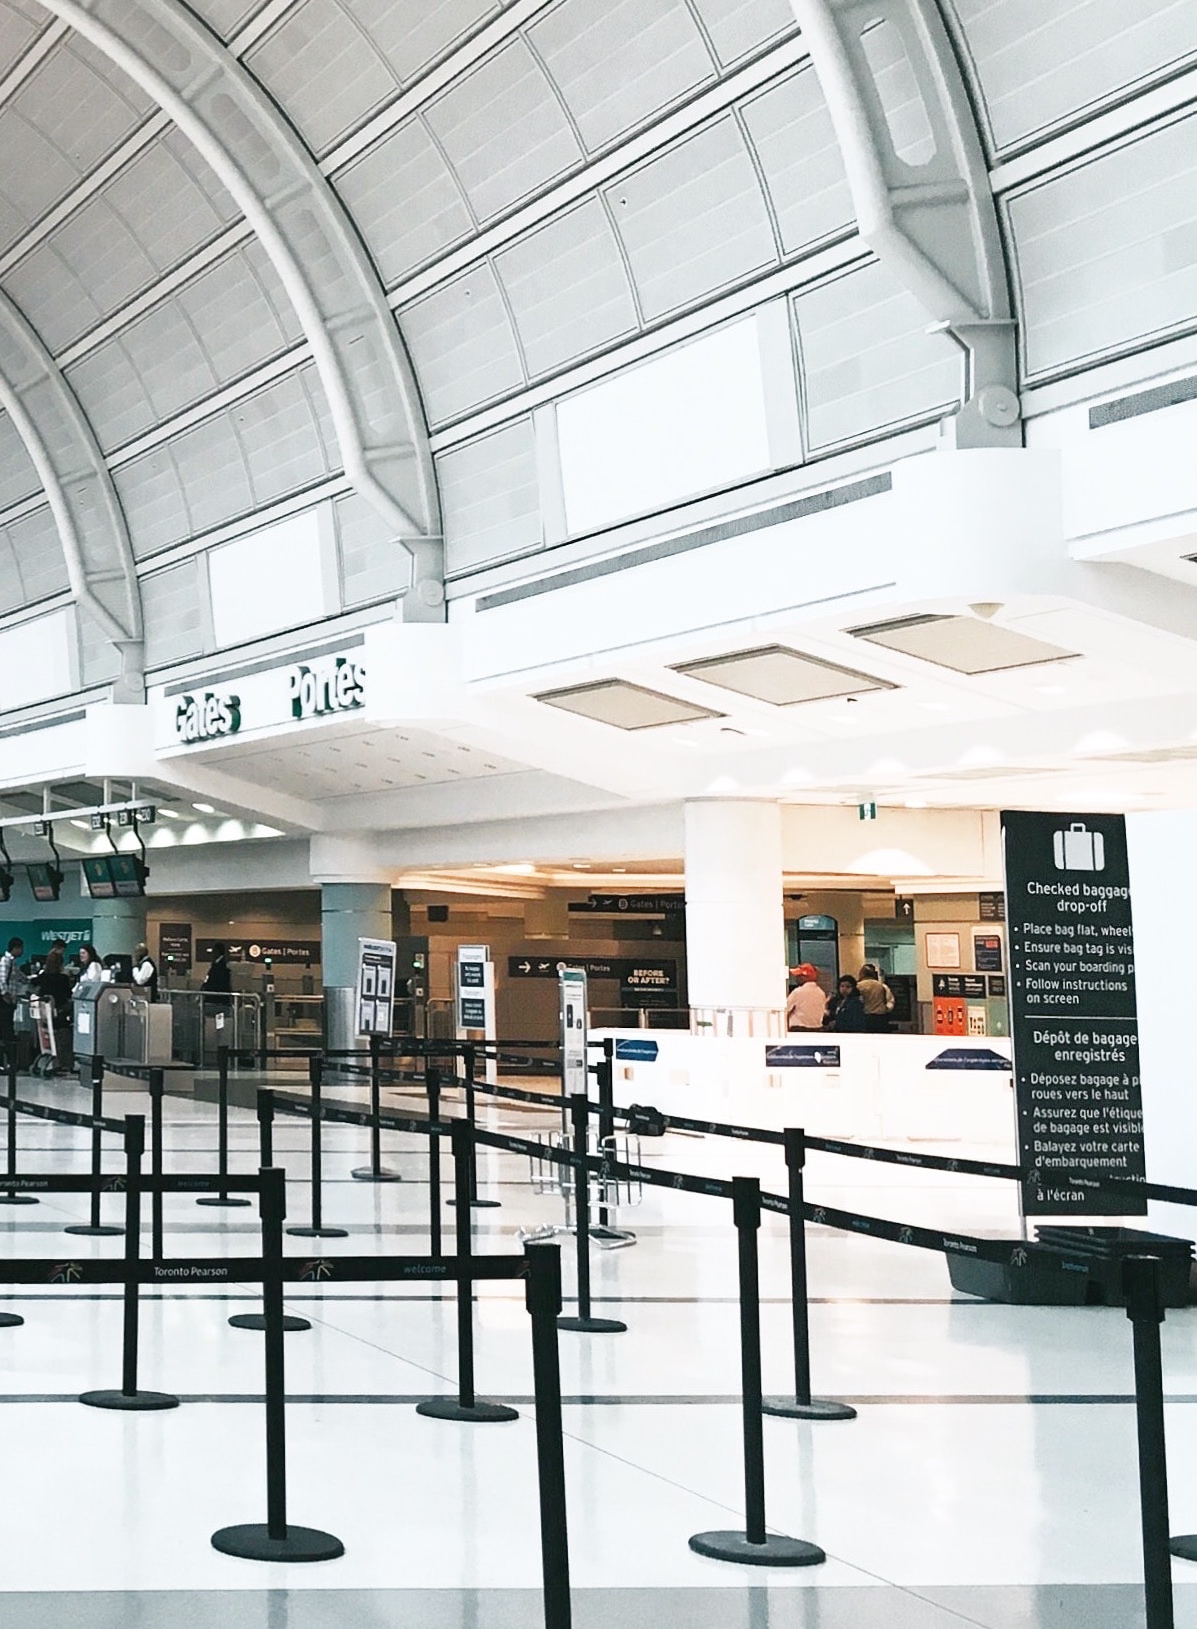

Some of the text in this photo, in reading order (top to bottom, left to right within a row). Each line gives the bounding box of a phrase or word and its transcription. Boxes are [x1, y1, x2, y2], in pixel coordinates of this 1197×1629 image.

[1027, 882, 1130, 900] Checked baggag
[1057, 900, 1107, 914] drop-off
[1023, 923, 1132, 938] Place bag flat, wheel
[1024, 941, 1134, 957] Ensure bag tag is vis
[633, 969, 664, 977] BEFORE
[1025, 959, 1135, 975] Scan your boarding p
[627, 976, 639, 984] OR
[1025, 978, 1128, 991] Follow instructions
[1026, 994, 1080, 1004] on screen
[1033, 1030, 1138, 1048] Dépôt de bagage
[1054, 1048, 1126, 1064] enregistrés
[1030, 1072, 1140, 1087] Déposez bagage à p
[1031, 1089, 1129, 1100] roues vers le haut
[1033, 1106, 1077, 1118] Assurez
[1079, 1109, 1100, 1120] que
[1033, 1121, 1048, 1133] de
[1050, 1122, 1090, 1136] bagage
[1093, 1122, 1110, 1133] est
[1034, 1140, 1140, 1154] Balayez votre carte
[1035, 1156, 1128, 1169] d'embarquement
[1037, 1188, 1085, 1201] à l'écran
[153, 1266, 228, 1277] Toronto Pearson
[403, 1264, 447, 1274] welcome
